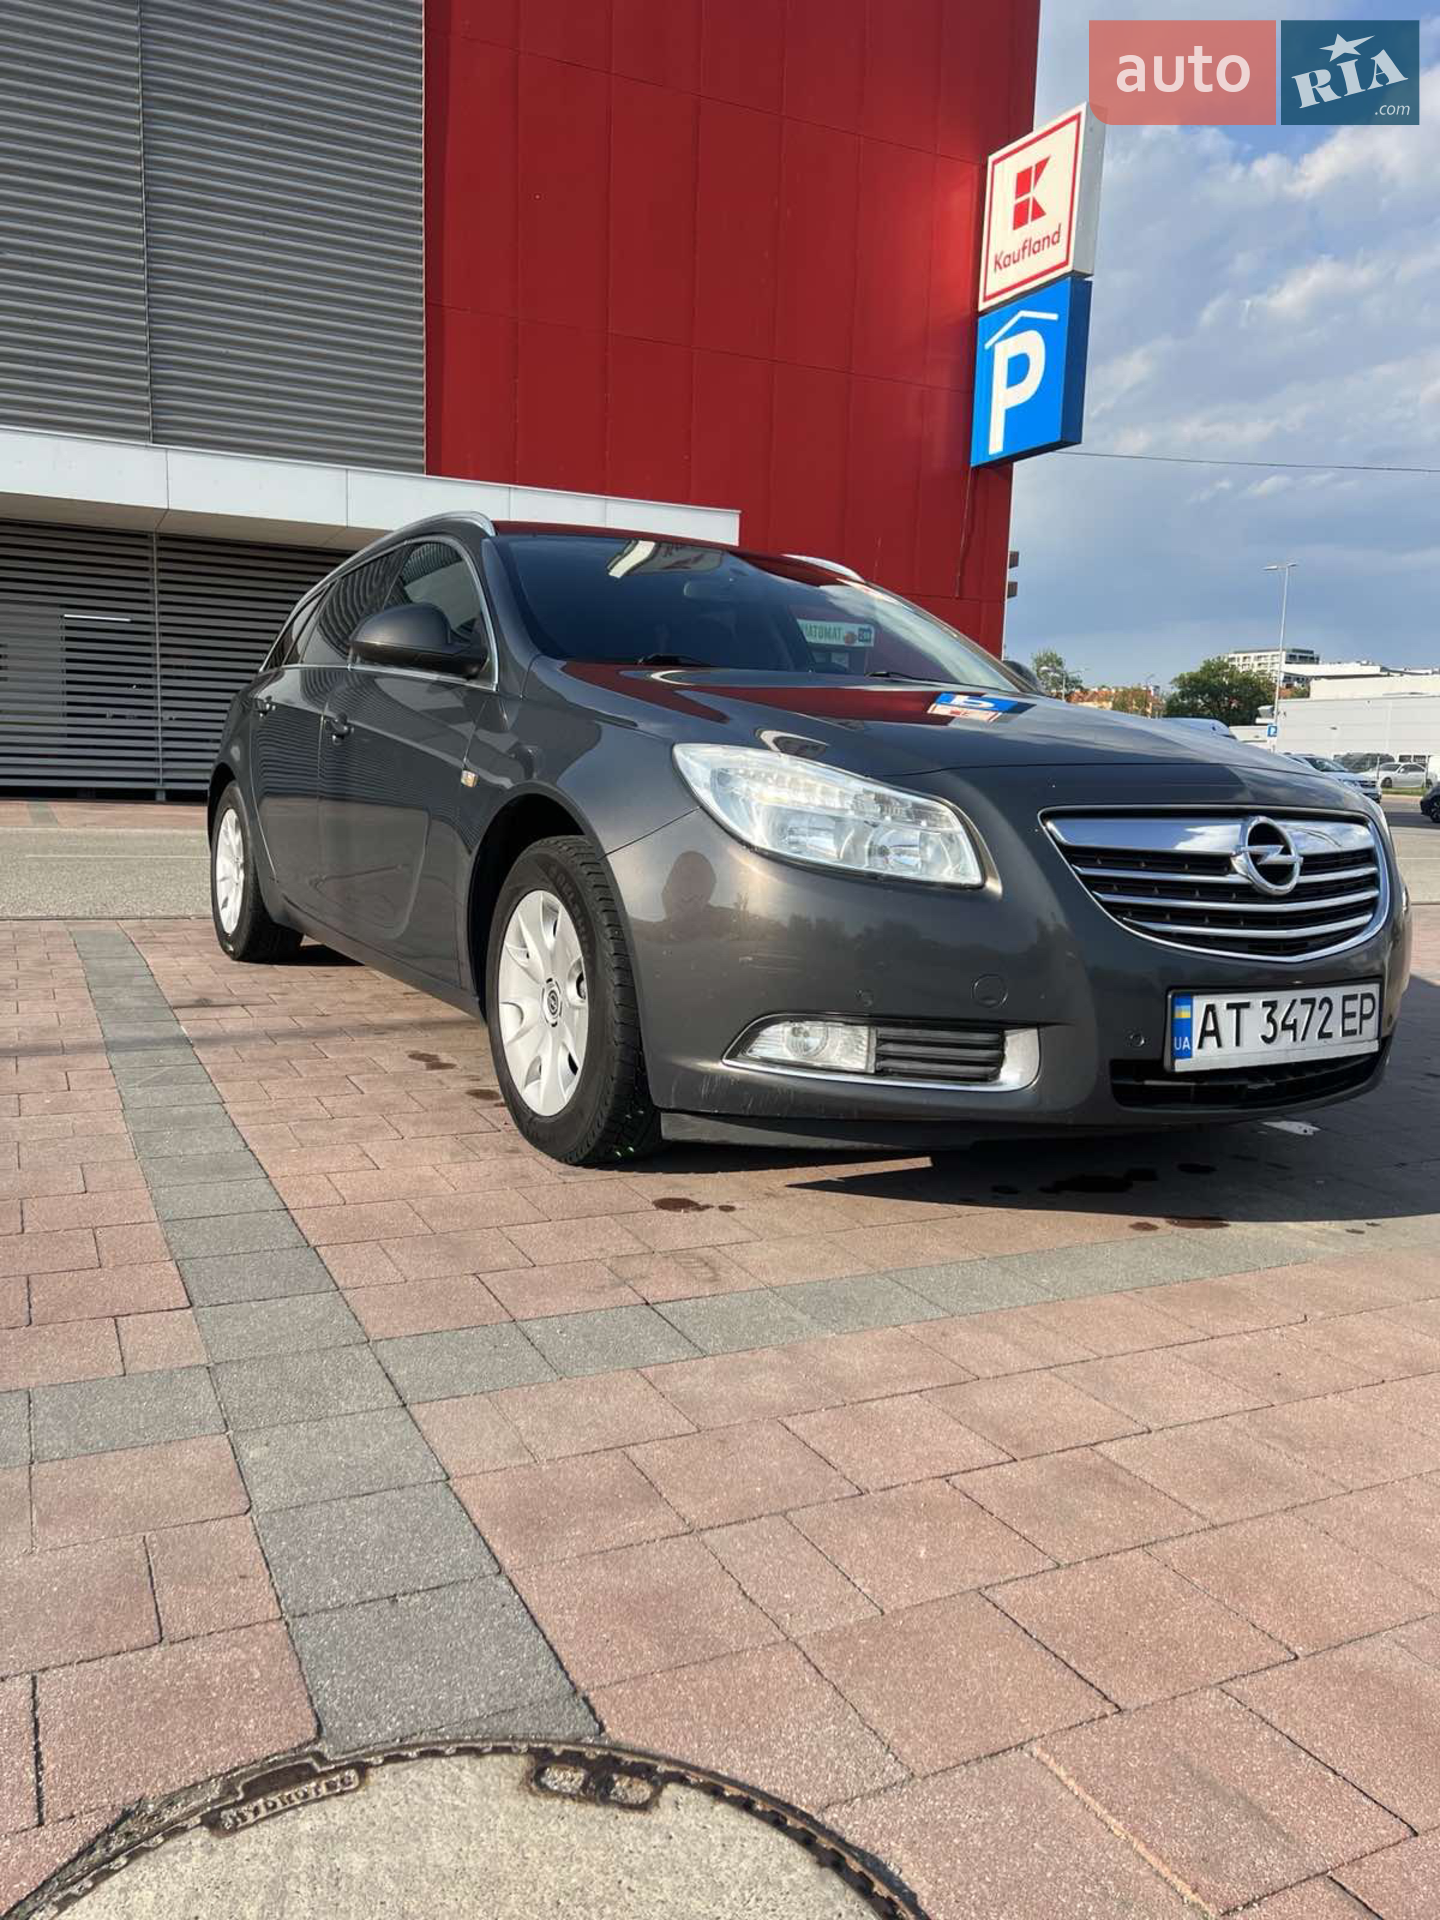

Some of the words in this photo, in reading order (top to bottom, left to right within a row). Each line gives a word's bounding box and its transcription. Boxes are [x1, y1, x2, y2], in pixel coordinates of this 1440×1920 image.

[994, 223, 1062, 272] Kaufland
[988, 330, 1046, 455] P
[1174, 1036, 1191, 1050] UA
[1197, 1001, 1251, 1050] AT
[1260, 997, 1333, 1045] 3472
[1340, 992, 1376, 1037] EP
